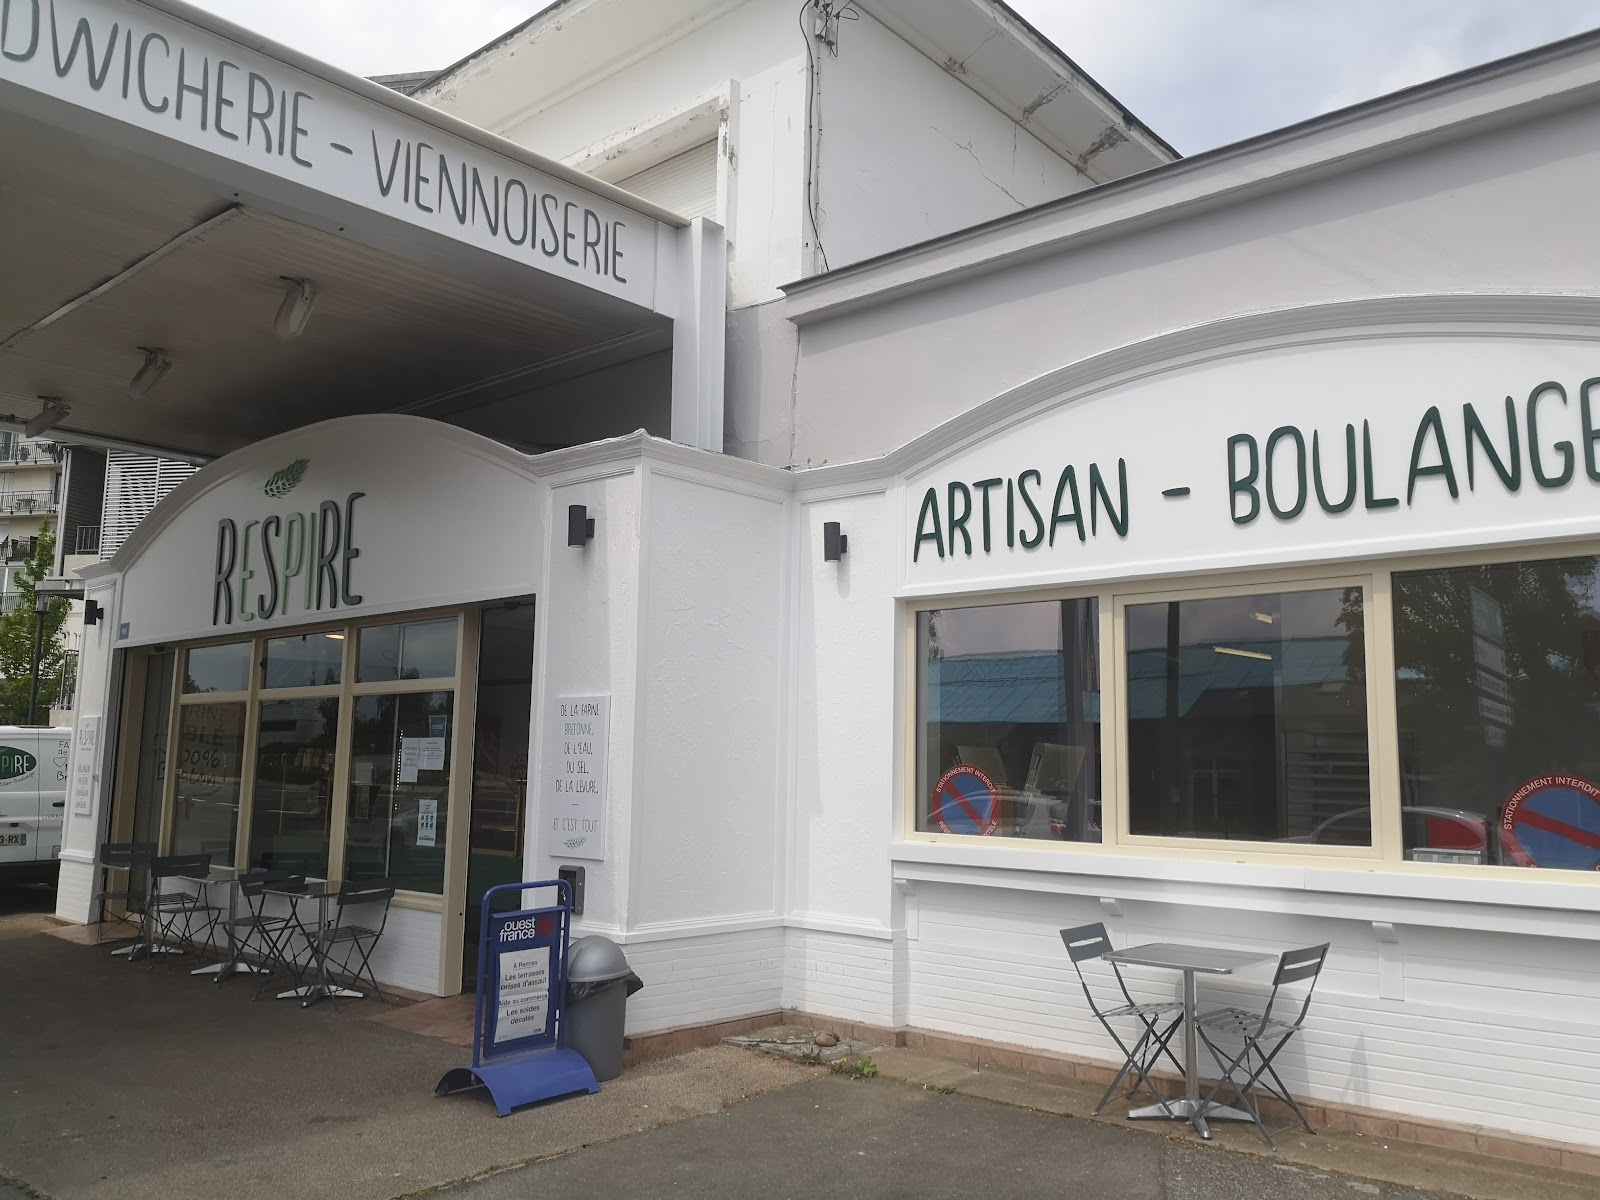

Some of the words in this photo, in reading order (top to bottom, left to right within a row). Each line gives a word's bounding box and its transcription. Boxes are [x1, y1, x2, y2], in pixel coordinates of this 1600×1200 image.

[371, 129, 627, 284] VIENNOISERIE
[914, 458, 1128, 563] ARTISAN
[212, 492, 365, 625] RESPIRE
[560, 704, 568, 717] DE
[570, 704, 579, 717] LA
[564, 742, 572, 755] DE
[566, 761, 575, 774] DU
[935, 766, 975, 793] STATIONNEMENT
[974, 769, 997, 793] INTERDIT
[555, 780, 563, 793] DE
[565, 780, 574, 793] LA
[1503, 776, 1553, 830] STATIONNEMENT
[1555, 776, 1600, 797] INTERDIT
[553, 817, 560, 831] ET
[581, 819, 598, 833] TOUT
[504, 916, 536, 932] ouest
[499, 928, 536, 943] france
[518, 960, 538, 969] Rennes
[517, 969, 545, 979] terrasses
[500, 982, 521, 991] prises
[522, 977, 547, 988] d'assaut
[520, 993, 548, 1003] commerce
[519, 1005, 540, 1014] soldes
[510, 1014, 535, 1025] décalés
